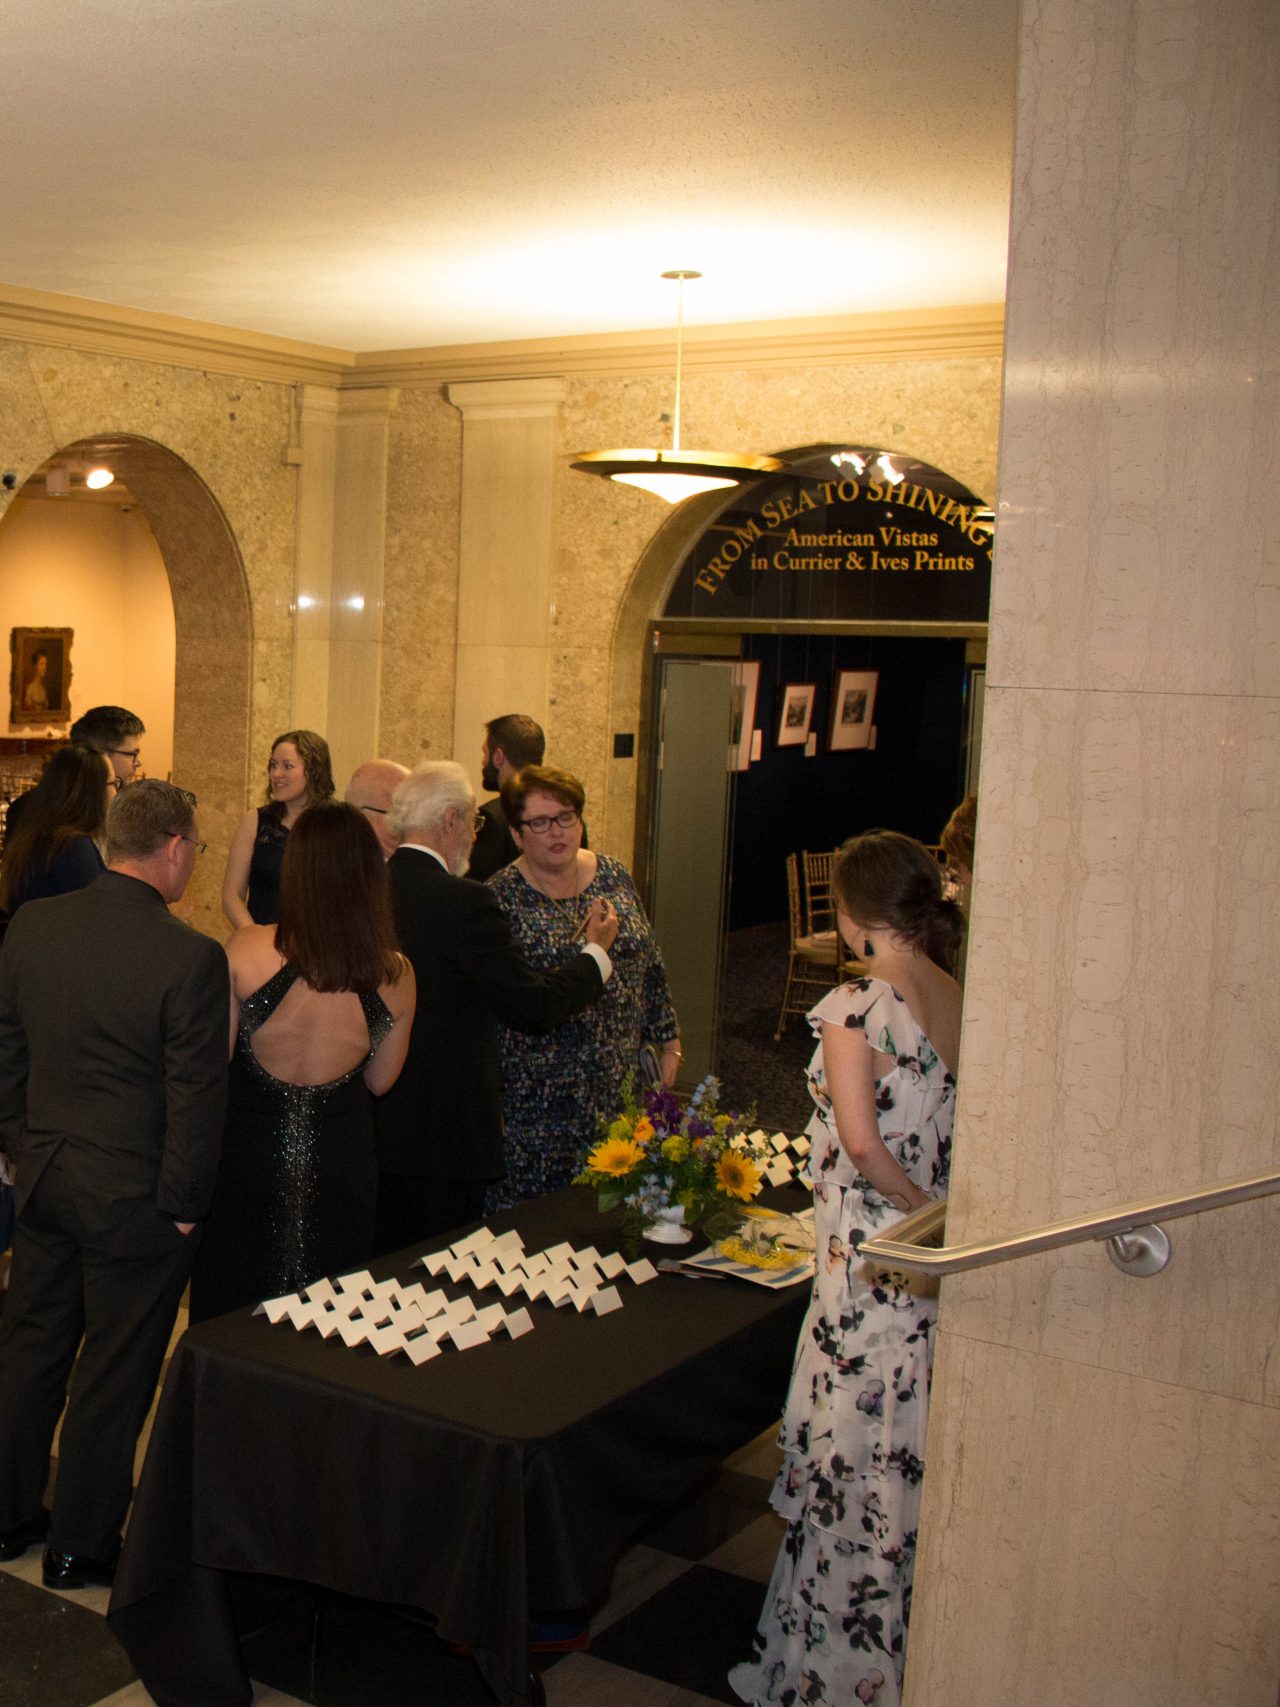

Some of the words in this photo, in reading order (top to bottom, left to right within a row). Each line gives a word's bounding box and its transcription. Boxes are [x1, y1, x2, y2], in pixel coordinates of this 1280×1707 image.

[696, 518, 764, 596] FROM
[761, 488, 818, 528] SEA
[818, 479, 860, 505] TO
[866, 478, 992, 546] SHINING
[784, 527, 875, 547] American
[879, 526, 939, 547] Vistas
[751, 553, 769, 570] in
[773, 551, 842, 570] Currier
[846, 551, 865, 570] &
[871, 551, 909, 570] Ives
[914, 551, 975, 570] Prints
